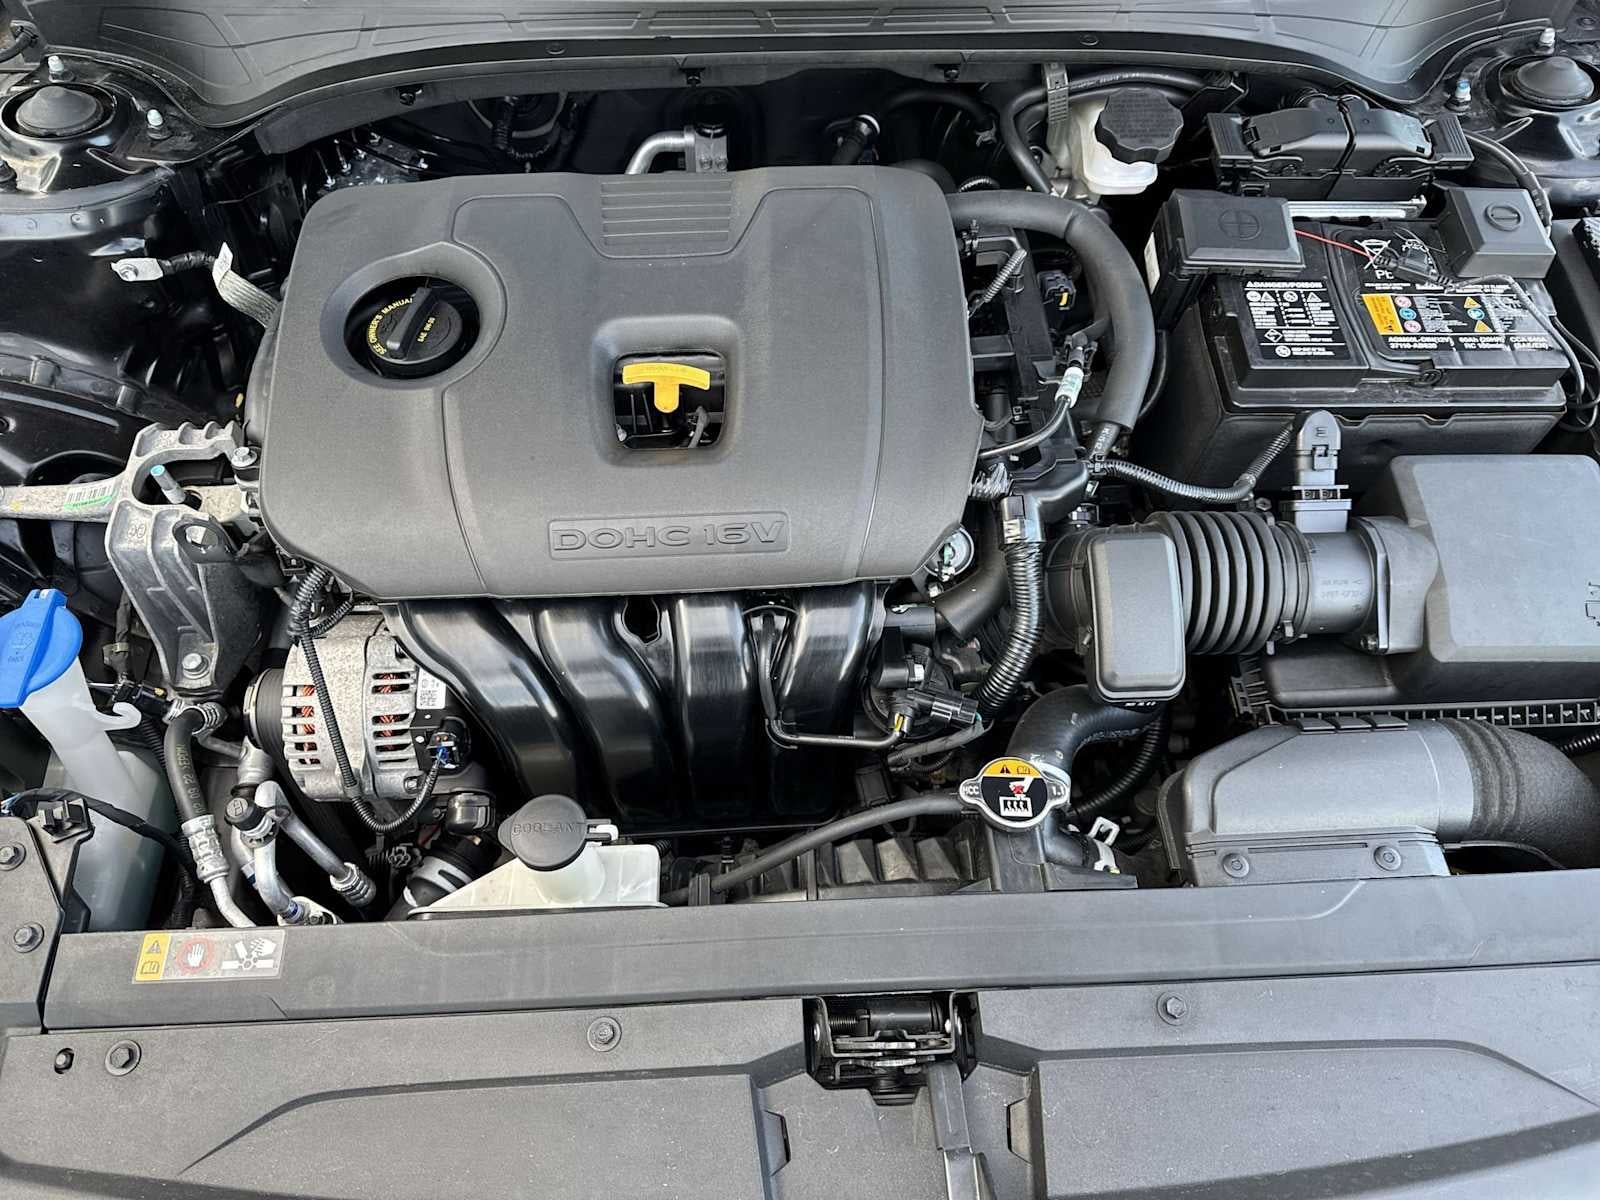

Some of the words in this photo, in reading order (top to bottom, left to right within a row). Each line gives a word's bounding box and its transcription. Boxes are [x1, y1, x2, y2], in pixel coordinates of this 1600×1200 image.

[373, 342, 387, 355] SEE
[552, 525, 692, 551] DOHC
[703, 520, 785, 546] 16V
[512, 821, 587, 834] COOLANT
